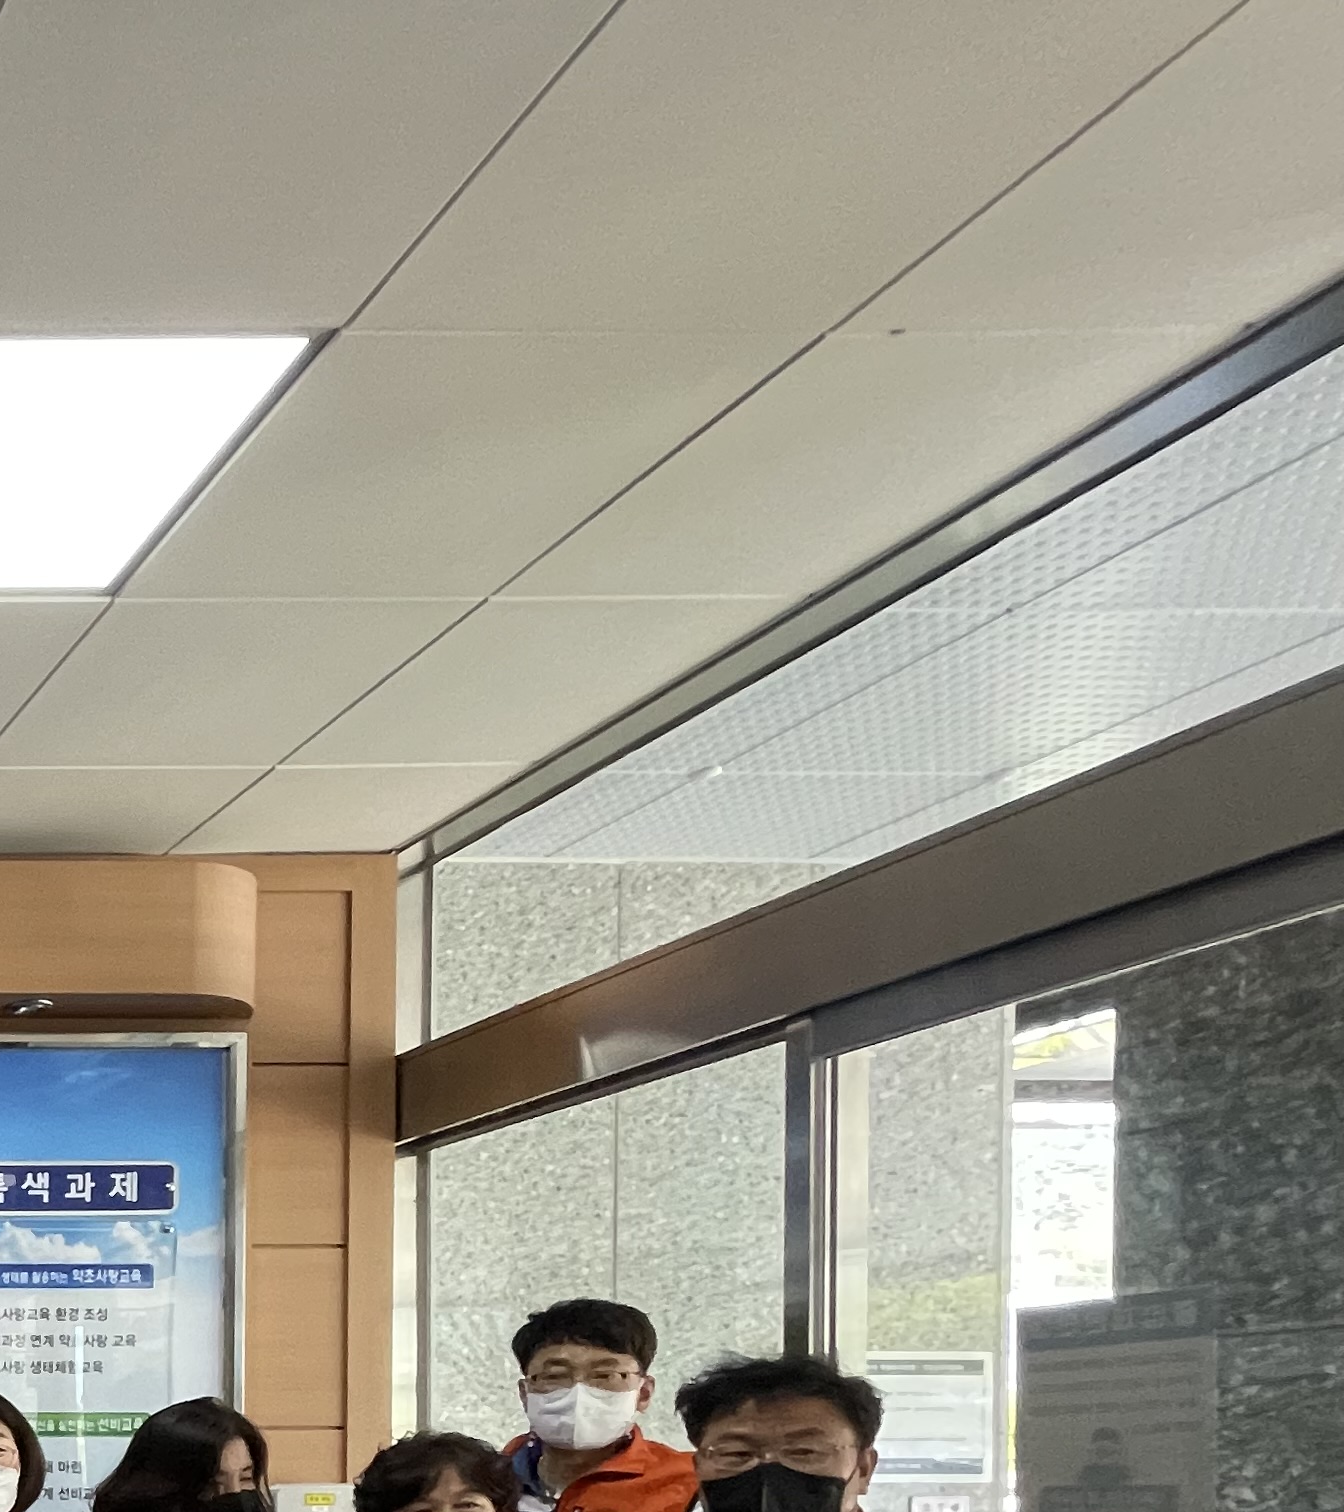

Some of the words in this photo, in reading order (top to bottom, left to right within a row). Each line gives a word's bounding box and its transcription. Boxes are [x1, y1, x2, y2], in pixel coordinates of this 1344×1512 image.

[72, 1268, 142, 1284] 약초사랑교육
[55, 1307, 79, 1322] 환경
[83, 1307, 109, 1322] 조성
[30, 1333, 55, 1348] 연계
[59, 1333, 108, 1348] 약사랑
[112, 1333, 137, 1348] 교육
